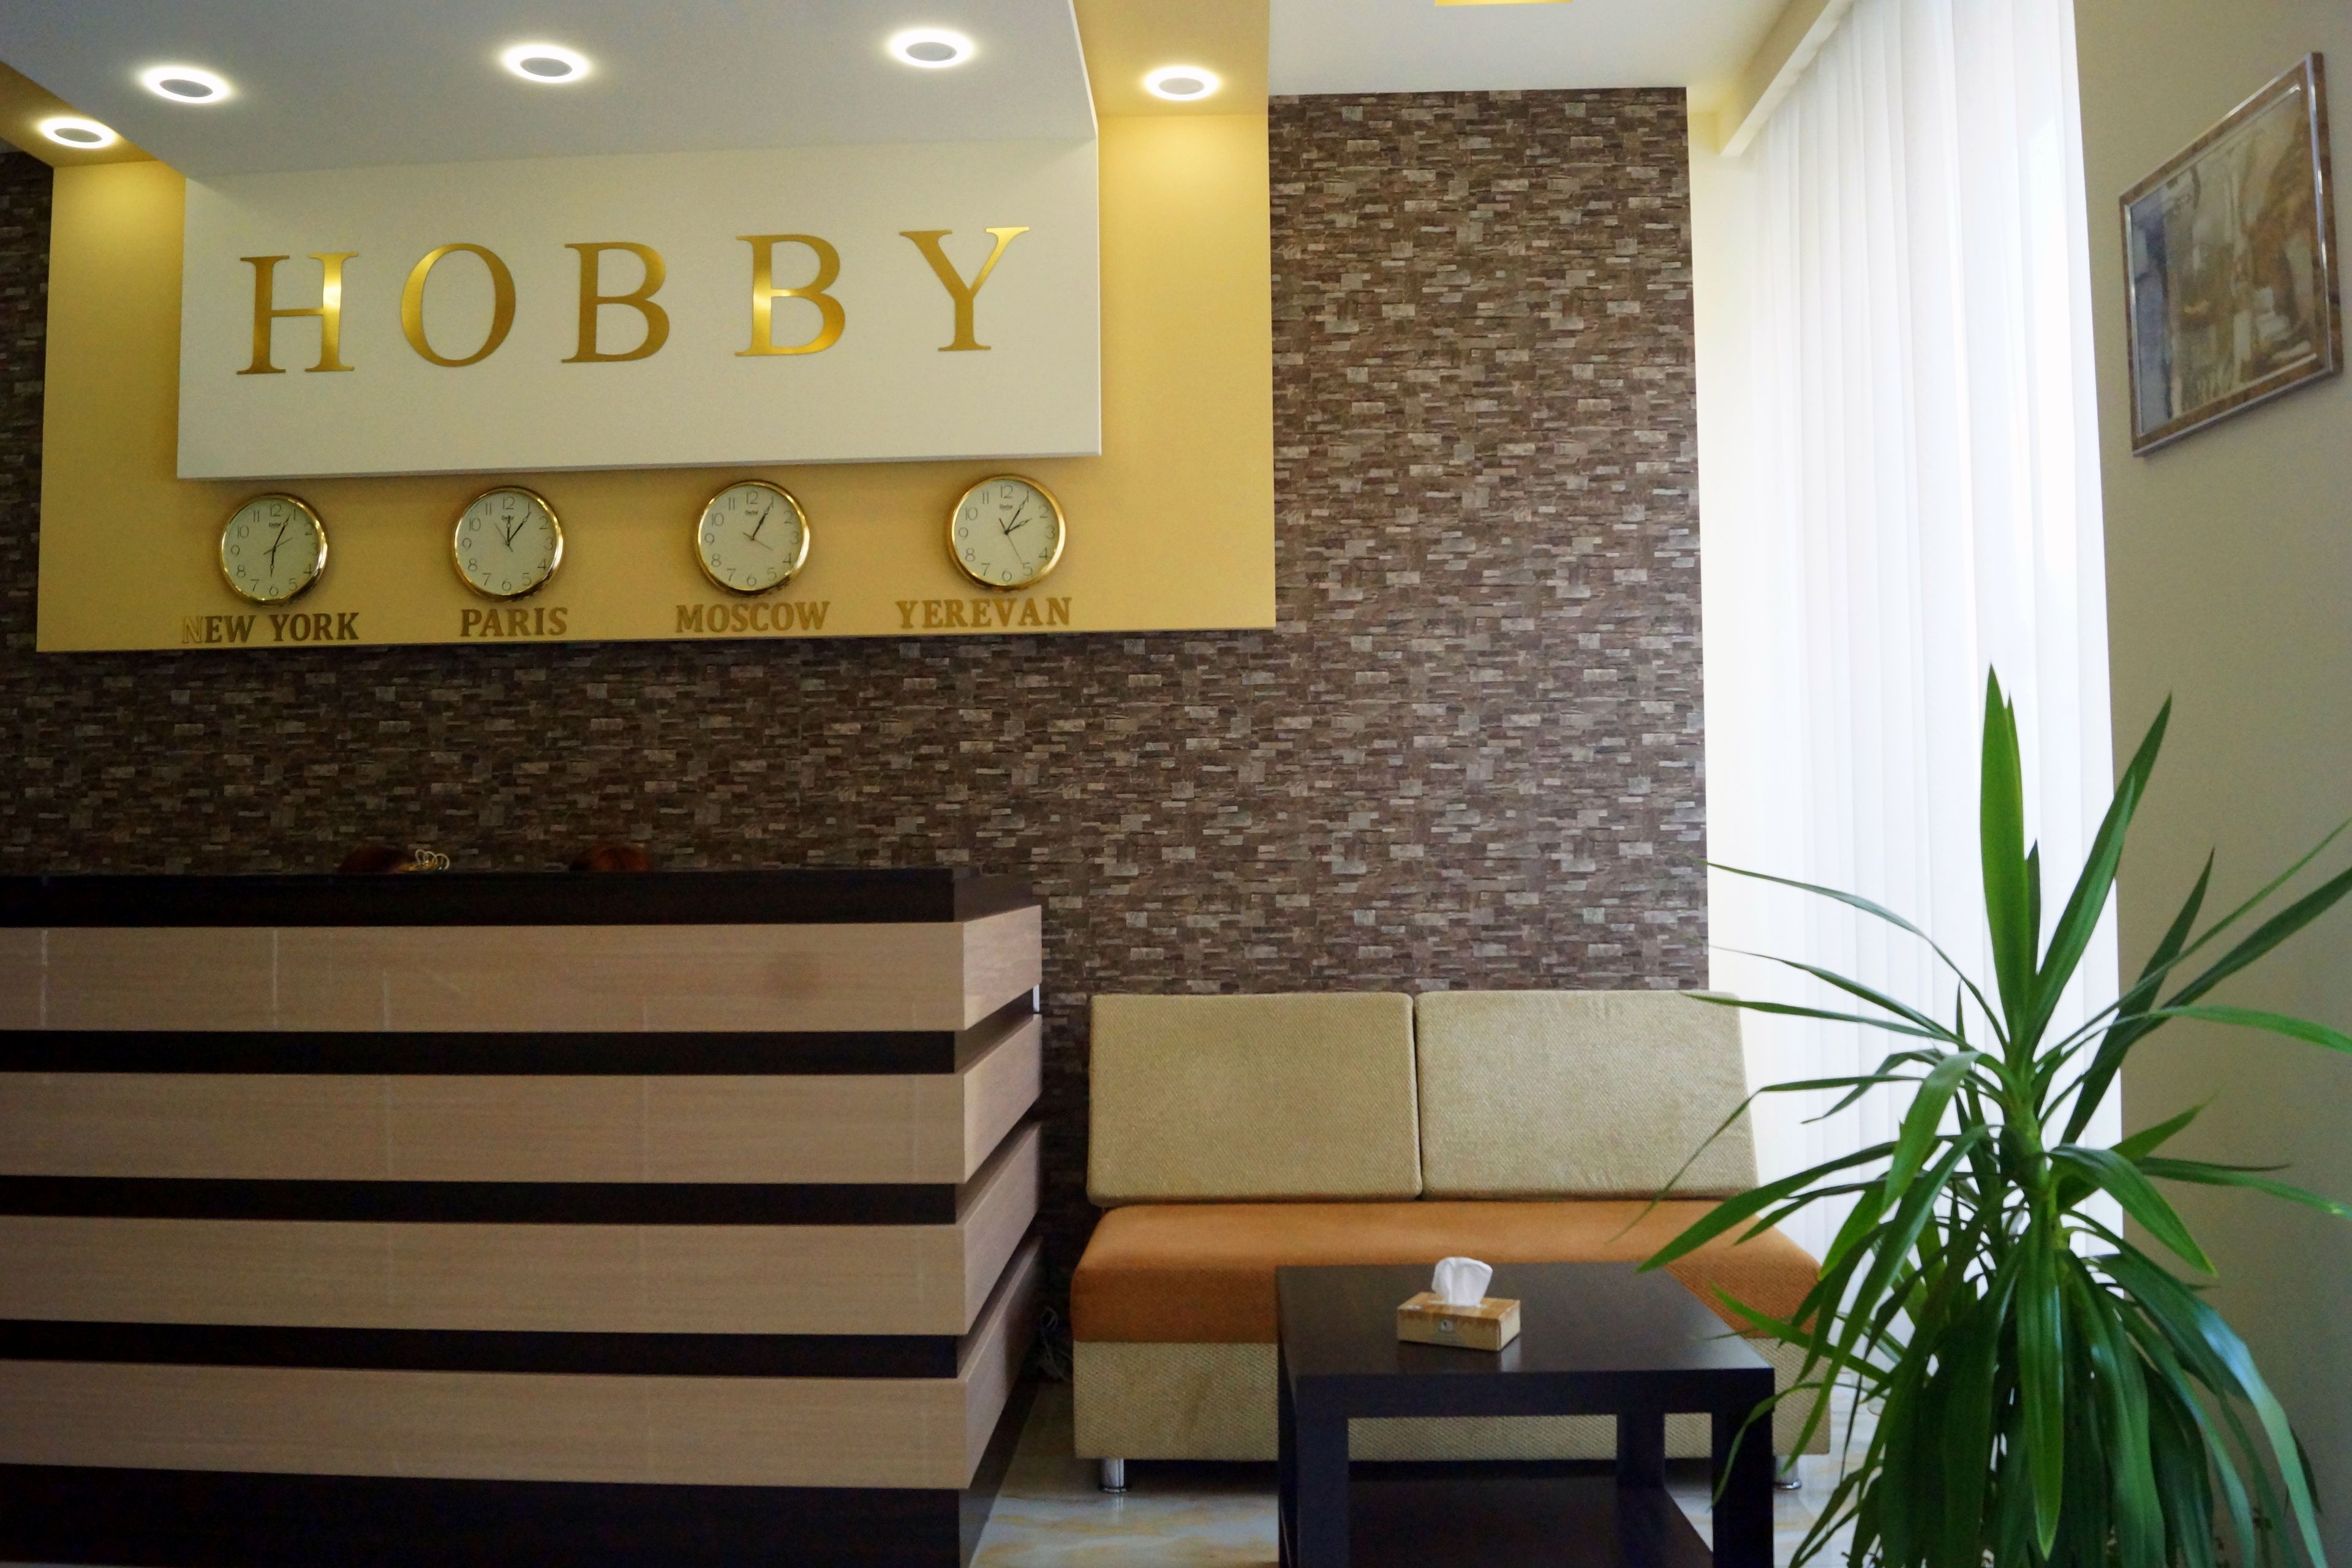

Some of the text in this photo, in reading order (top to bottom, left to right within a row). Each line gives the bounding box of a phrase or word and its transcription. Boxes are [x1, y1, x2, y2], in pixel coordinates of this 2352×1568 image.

[236, 225, 1030, 375] HOBBY
[746, 491, 758, 504] 12
[982, 491, 989, 504] 11
[1000, 485, 1013, 499] 12
[270, 503, 281, 517] 12
[486, 503, 492, 516] 11
[503, 497, 514, 510] 12
[728, 497, 735, 510] 11
[253, 510, 260, 522] 11
[783, 510, 793, 524] 2
[965, 507, 978, 520] 10
[1039, 505, 1049, 518] 2
[469, 518, 481, 531] 10
[539, 516, 548, 529] 2
[712, 513, 724, 526] 10
[238, 526, 249, 538] 10
[305, 522, 313, 535] 2
[959, 527, 968, 540] 9
[1046, 526, 1055, 539] 3
[462, 538, 472, 549] 9
[545, 538, 553, 550] 3
[704, 533, 715, 545] 9
[790, 531, 799, 545] 3
[231, 544, 240, 556] 9
[309, 543, 318, 556] 3
[965, 548, 976, 562] 8
[1038, 547, 1047, 559] 4
[537, 559, 546, 570] 4
[711, 554, 721, 567] 8
[783, 552, 791, 564] 4
[236, 564, 246, 578] 8
[304, 564, 312, 576] 4
[468, 559, 477, 571] 8
[981, 563, 990, 576] 7
[1023, 562, 1033, 576] 5
[483, 573, 492, 586] 7
[522, 573, 532, 586] 5
[727, 568, 735, 581] 7
[747, 574, 756, 586] 6
[767, 567, 777, 581] 5
[1001, 569, 1012, 581] 6
[251, 579, 260, 591] 7
[270, 584, 279, 597] 6
[288, 578, 298, 590] 5
[502, 578, 511, 591] 6
[675, 601, 831, 633] MOSCOW
[895, 597, 1072, 629] YEREVAN
[182, 611, 360, 644] NEW YORK
[460, 606, 568, 637] PARIS
